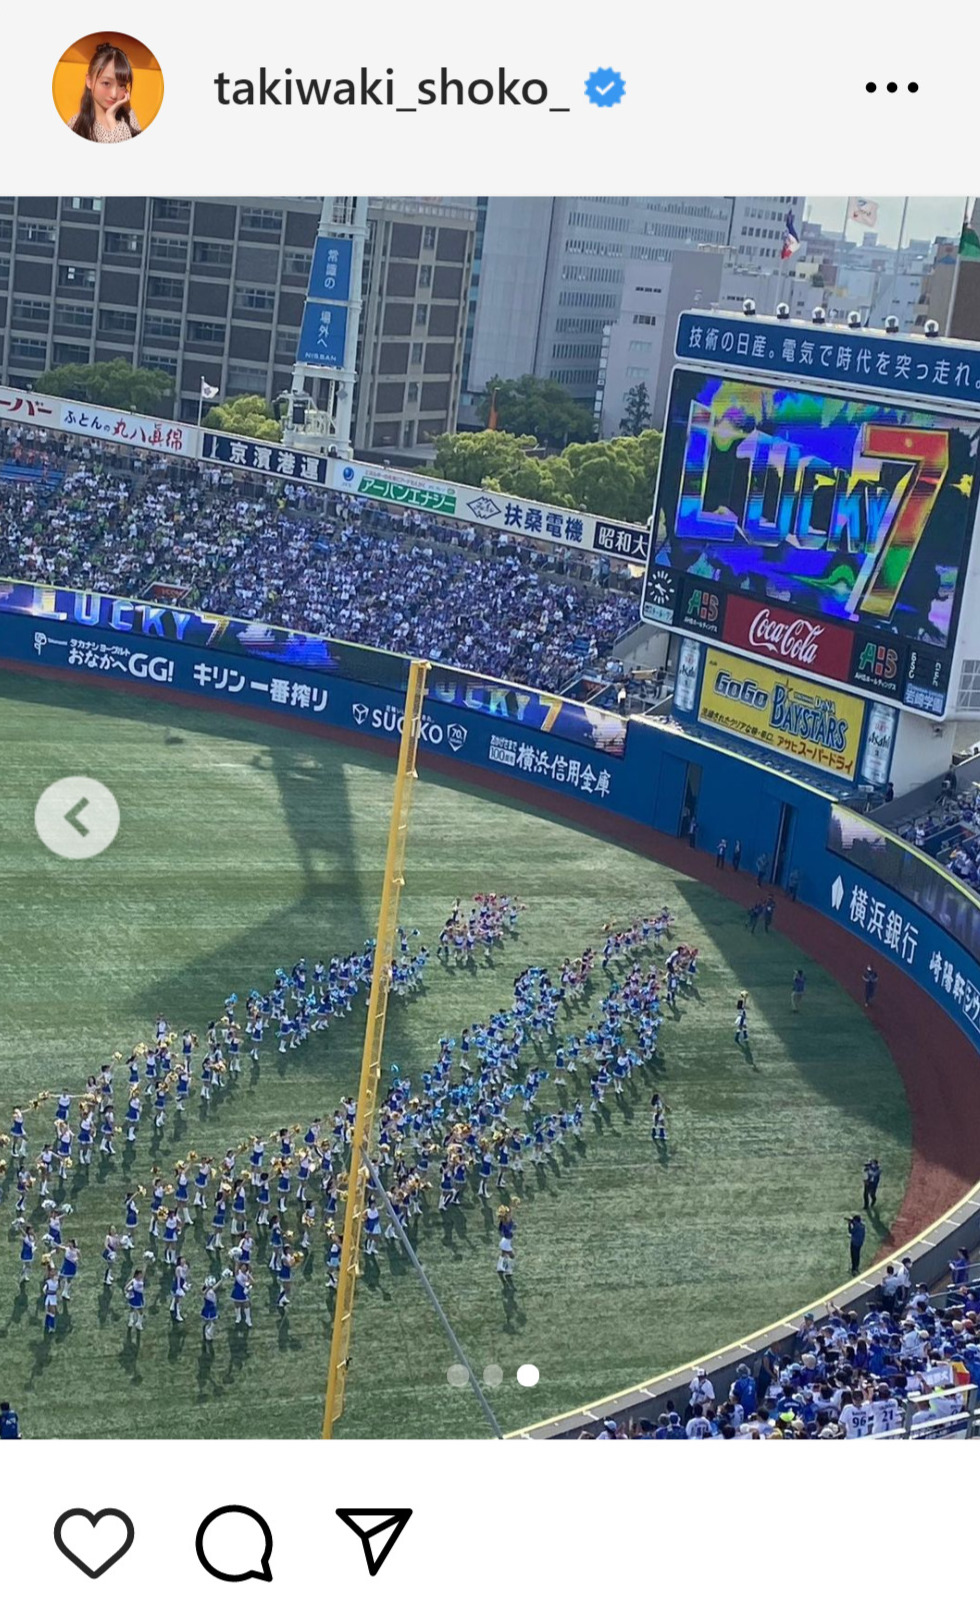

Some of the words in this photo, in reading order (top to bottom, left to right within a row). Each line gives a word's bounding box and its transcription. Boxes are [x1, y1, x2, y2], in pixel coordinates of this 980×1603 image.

[305, 352, 337, 361] NISSAN
[361, 478, 455, 509] アーバンエナジー
[675, 400, 893, 553] LUCKY
[846, 423, 950, 622] 7
[504, 503, 583, 543] 扶桑電機
[32, 582, 191, 641] LUCKY
[199, 611, 231, 647] 7
[748, 608, 825, 664] Coca-Cola
[424, 681, 531, 721] UCKY
[539, 695, 563, 732] 7
[714, 669, 769, 709] GoGo
[769, 682, 848, 753] BAYSTARS
[516, 742, 611, 797] 横浜信用金庫
[777, 735, 854, 774] アサヒスーパードライ
[850, 884, 919, 964] 横浜銀行
